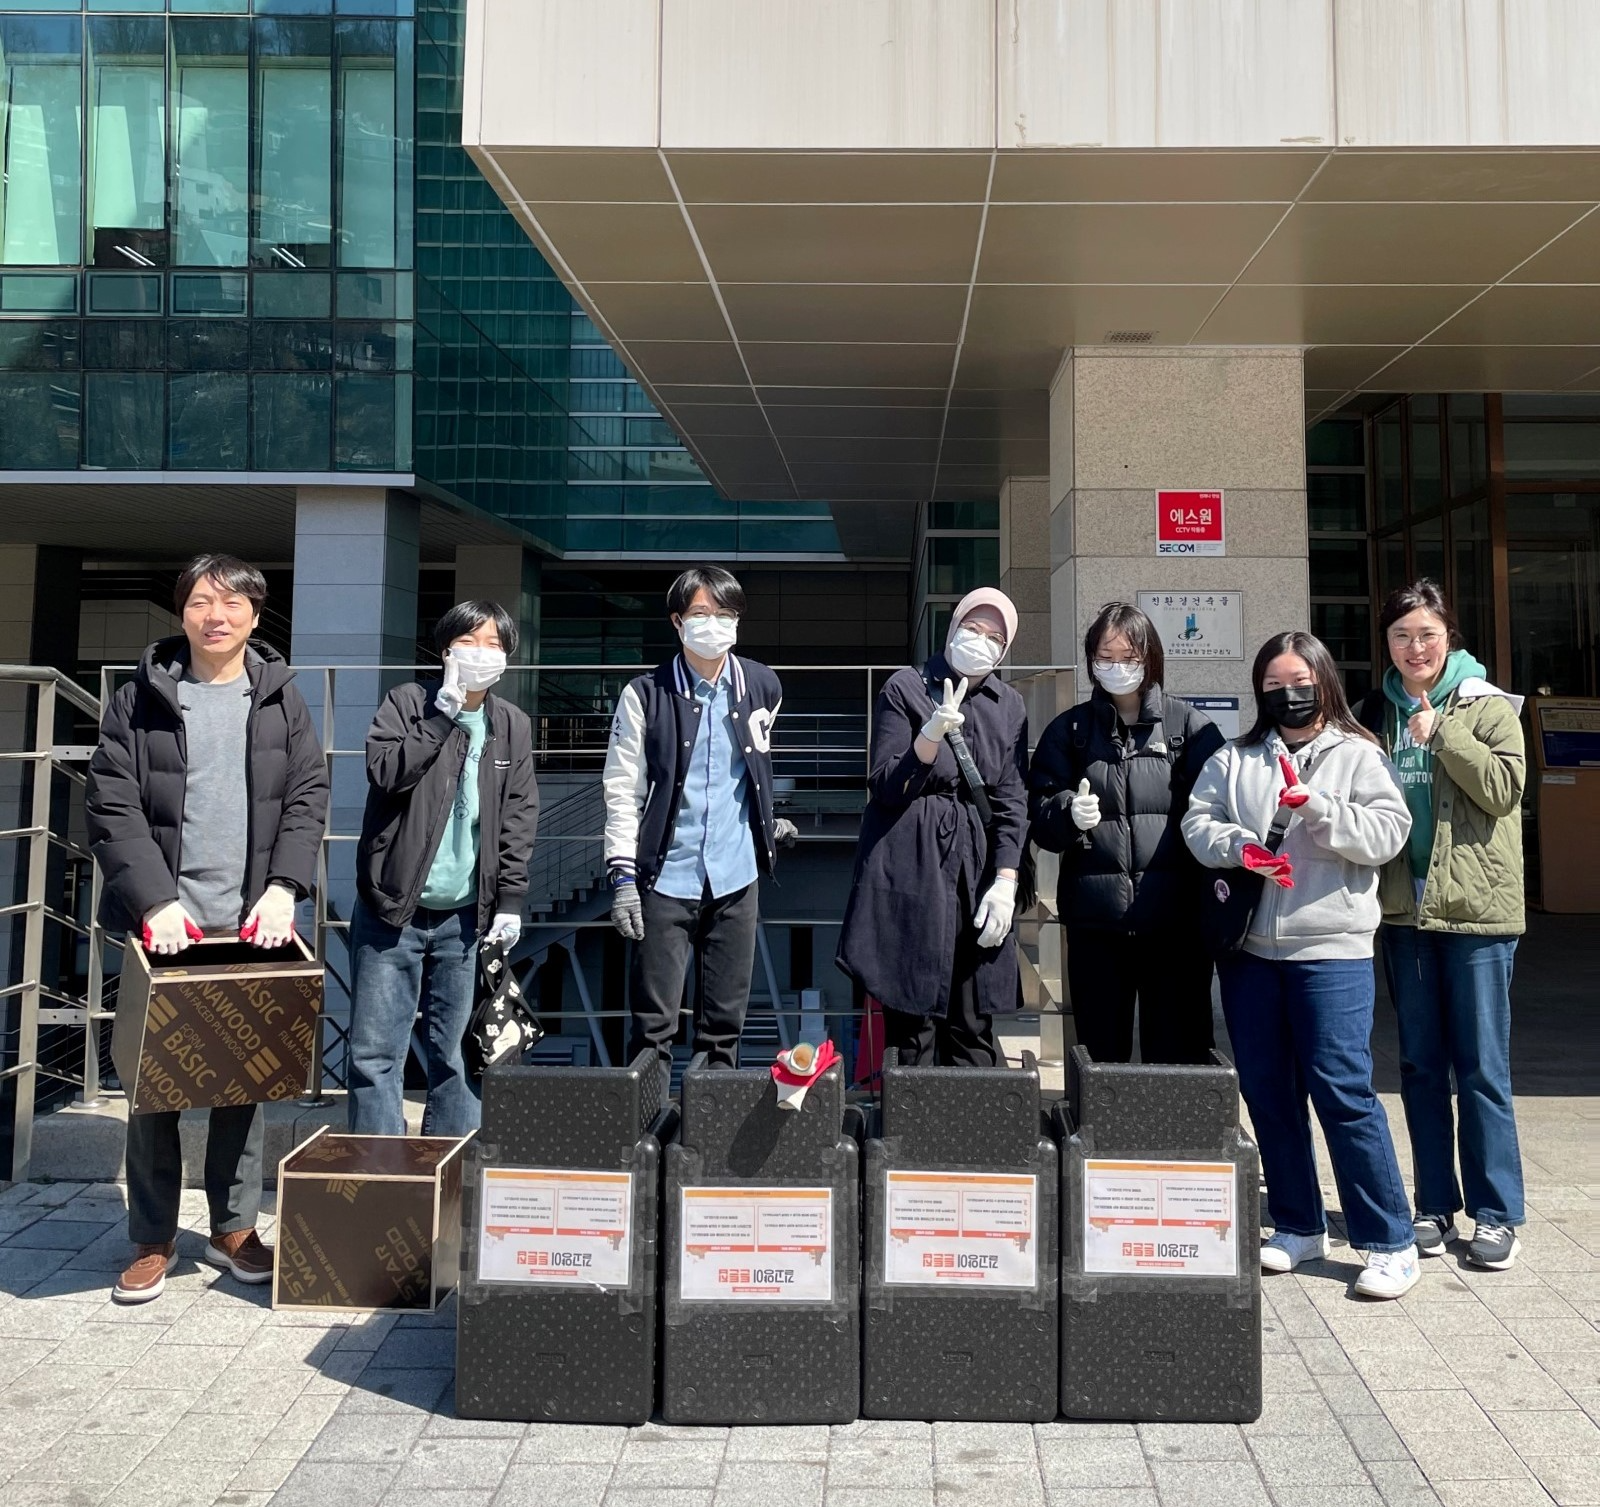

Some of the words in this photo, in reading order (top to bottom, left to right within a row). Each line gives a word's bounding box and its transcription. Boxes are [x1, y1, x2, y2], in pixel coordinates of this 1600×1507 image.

[1170, 508, 1212, 524] 에스원
[1160, 544, 1194, 552] SECOM
[748, 707, 770, 754] C
[179, 1023, 206, 1050] FORM
[192, 999, 213, 1024] FACED
[213, 1022, 246, 1061] PLYWOOD
[278, 1030, 296, 1050] FILM
[162, 1030, 217, 1088] BASIC
[386, 1226, 429, 1290] WOOD
[552, 1252, 592, 1266] 길고양이
[958, 1254, 998, 1268] 길고양이
[1158, 1244, 1199, 1258] 길고양이
[375, 1244, 416, 1300] STAR
[754, 1269, 794, 1283] 길고양이
